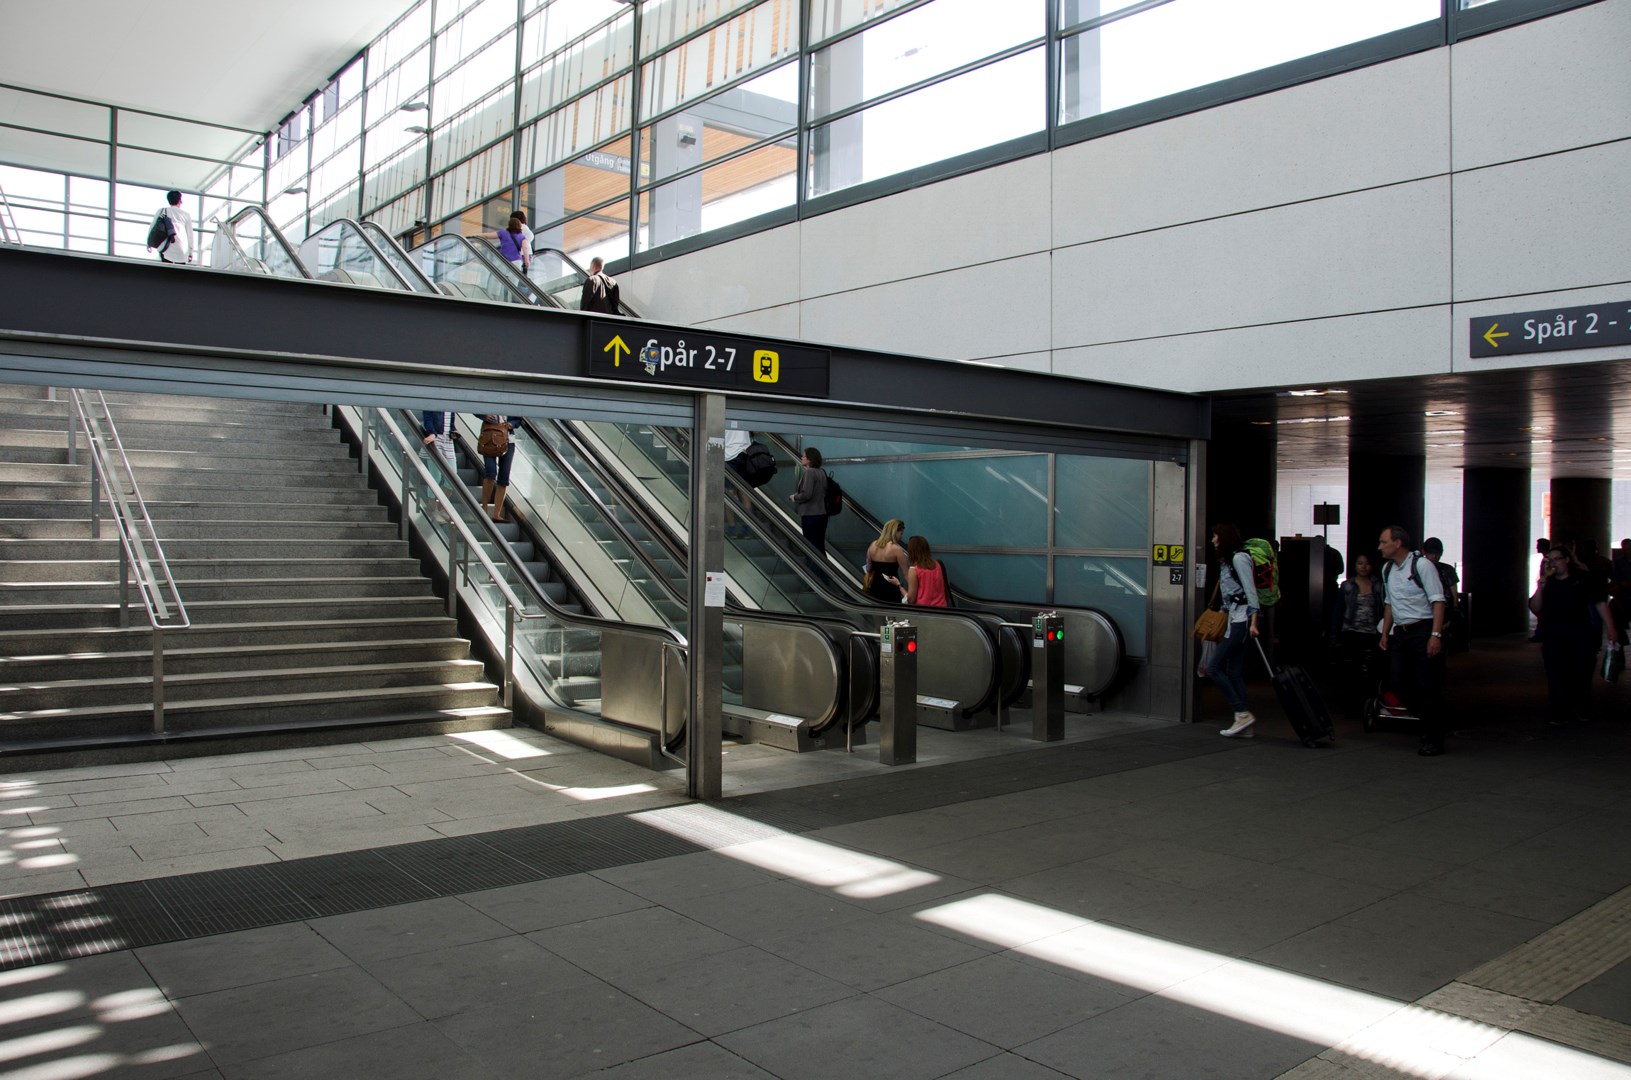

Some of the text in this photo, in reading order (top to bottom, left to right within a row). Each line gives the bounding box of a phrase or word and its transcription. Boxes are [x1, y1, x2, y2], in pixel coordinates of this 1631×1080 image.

[1523, 314, 1577, 345] Spår
[1585, 312, 1599, 334] 2
[704, 345, 736, 372] 2-7
[1172, 573, 1182, 582] 2-7
